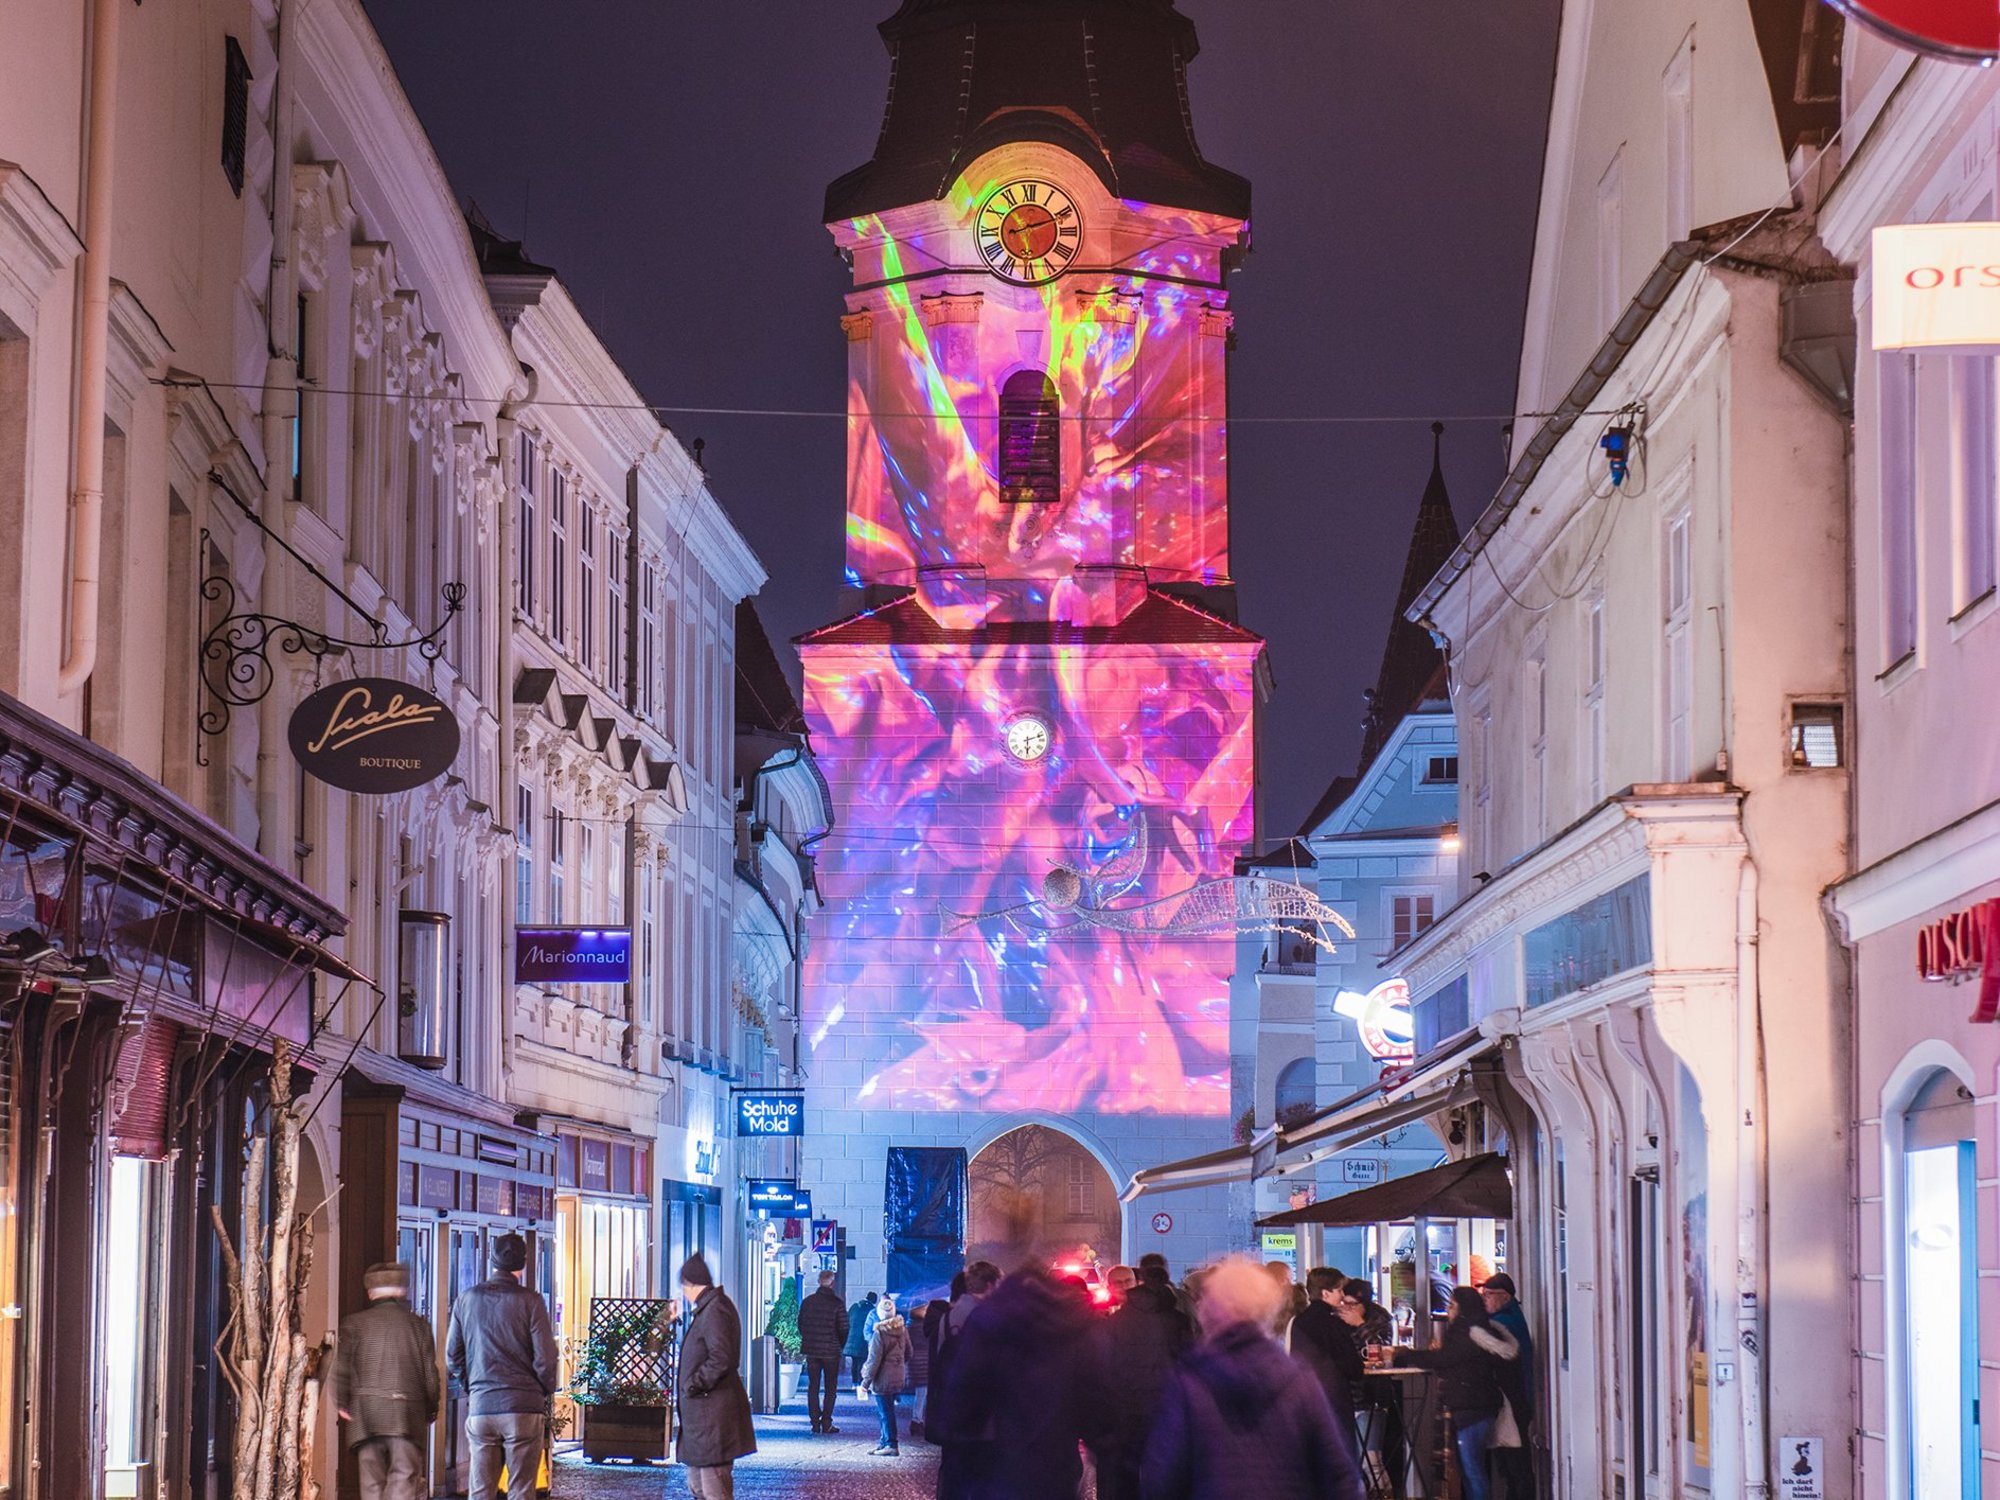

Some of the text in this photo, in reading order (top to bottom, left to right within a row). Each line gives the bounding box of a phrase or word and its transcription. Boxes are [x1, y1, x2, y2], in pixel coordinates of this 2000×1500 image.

[307, 687, 441, 752] Scala
[360, 757, 422, 769] BOUTIQUE
[521, 945, 625, 969] Marionnaud
[743, 1100, 798, 1117] Schuhe
[750, 1116, 789, 1133] Mold
[1268, 1236, 1293, 1245] krems
